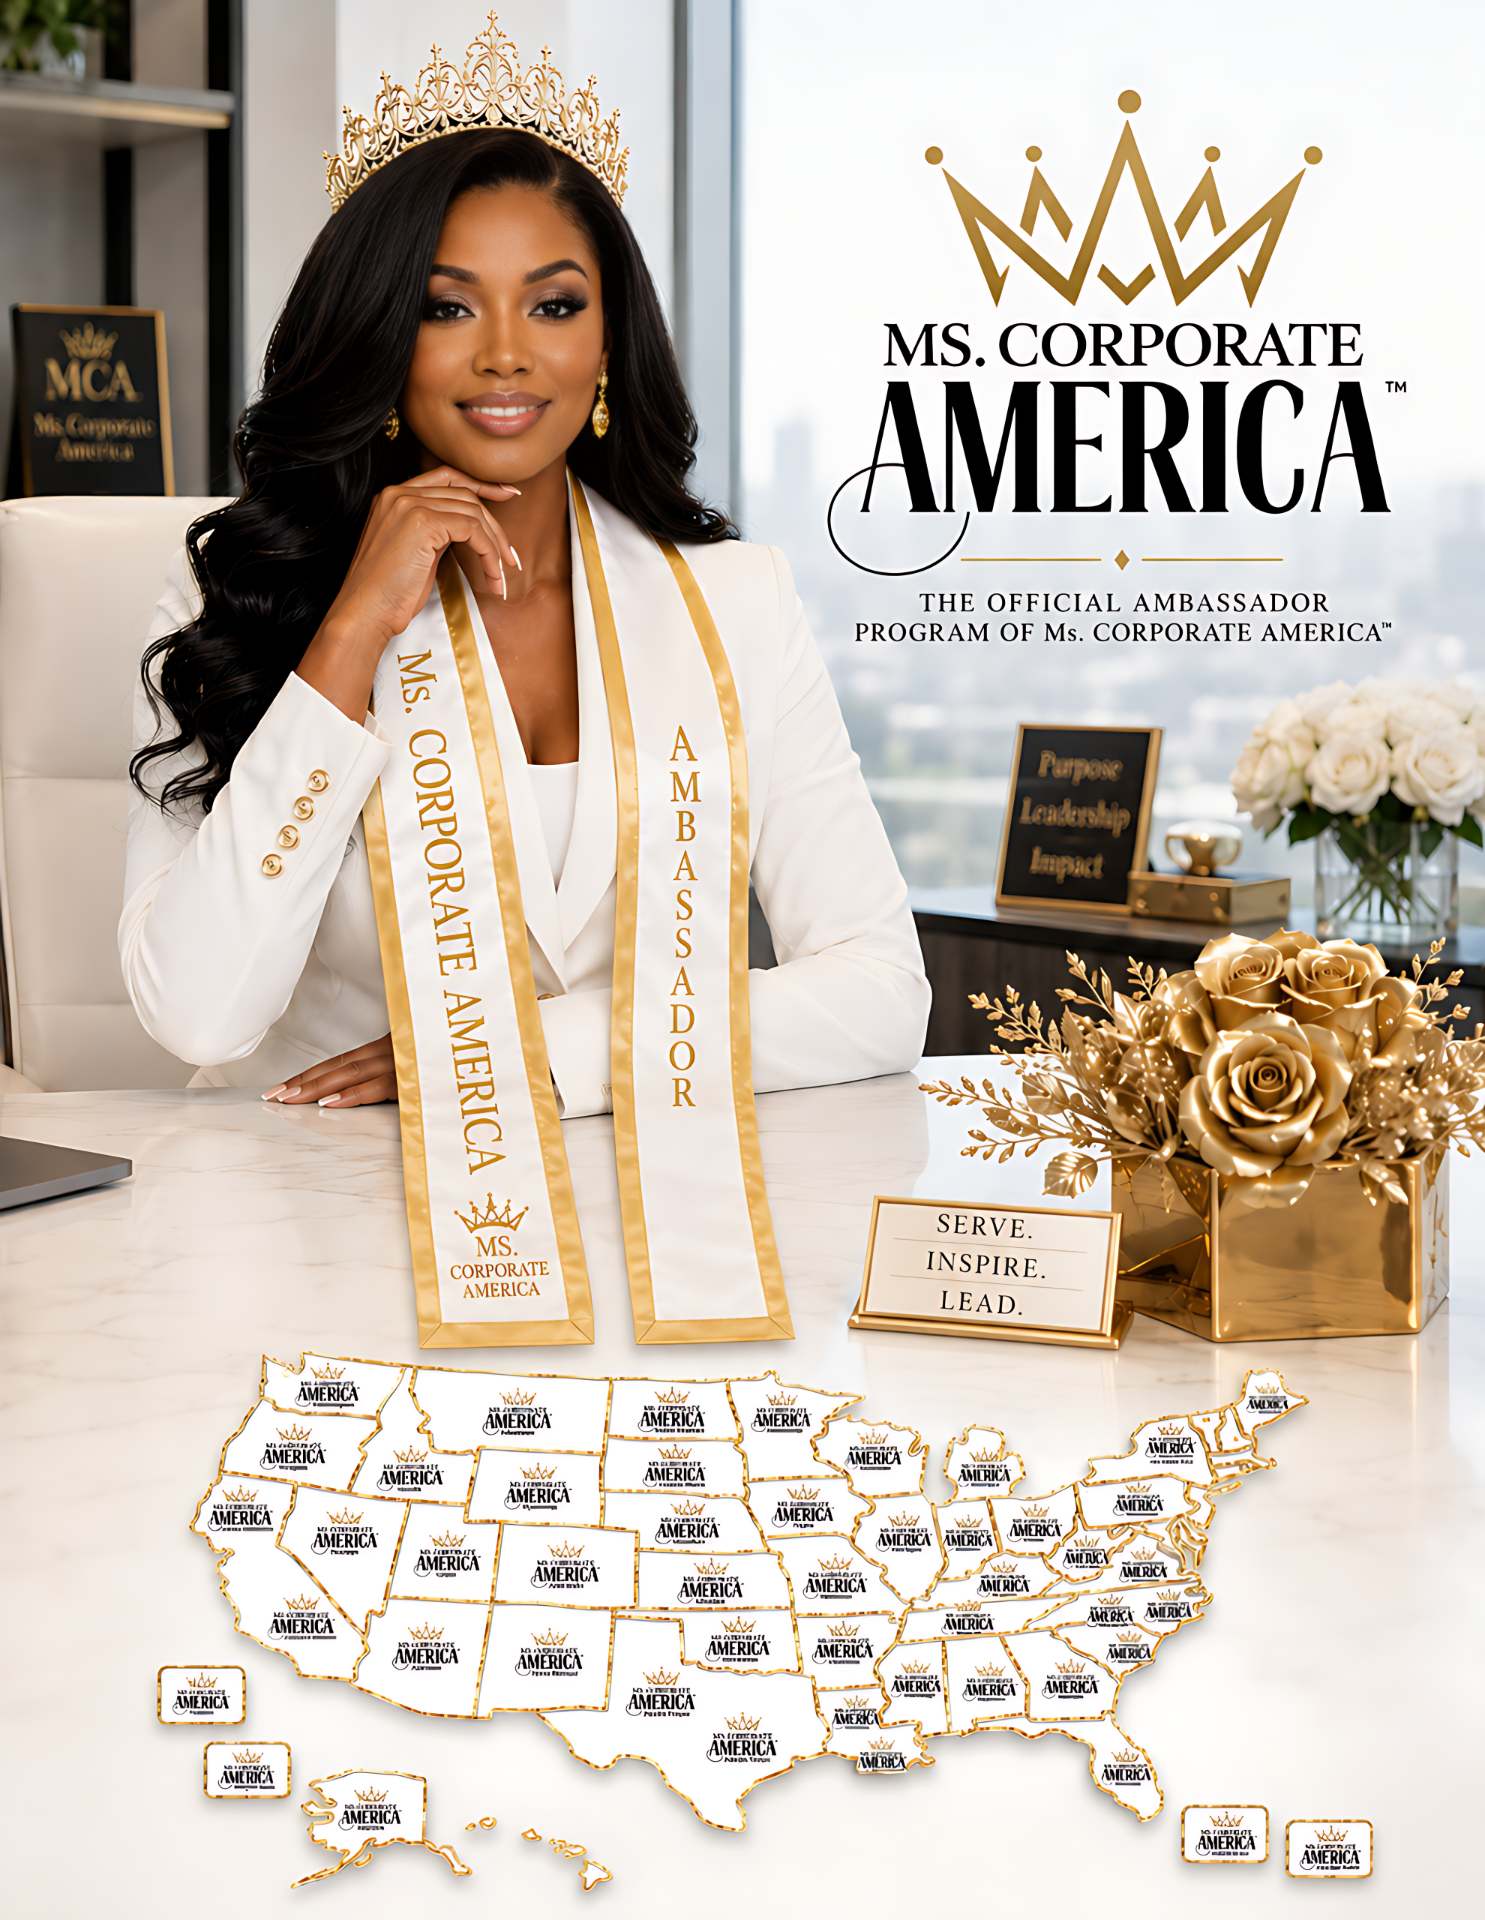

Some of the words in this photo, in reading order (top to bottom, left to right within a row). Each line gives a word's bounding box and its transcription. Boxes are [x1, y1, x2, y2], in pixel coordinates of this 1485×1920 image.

[45, 358, 144, 402] MCA
[397, 648, 434, 715] Ms.
[1038, 750, 1123, 787] Purpose
[1019, 796, 1131, 838] Leadership
[408, 728, 477, 978] CORPORATE
[1029, 846, 1104, 884] Impact
[669, 725, 702, 1108] AMBASSADOR
[443, 990, 508, 1176] AMERICA
[936, 1213, 1033, 1239] SERVE.
[476, 1235, 519, 1257] MS.
[450, 1259, 550, 1280] CORPORATE
[926, 1251, 1046, 1279] INSPIRE.
[462, 1280, 541, 1298] AMERICA
[939, 1290, 1023, 1316] LEAD.
